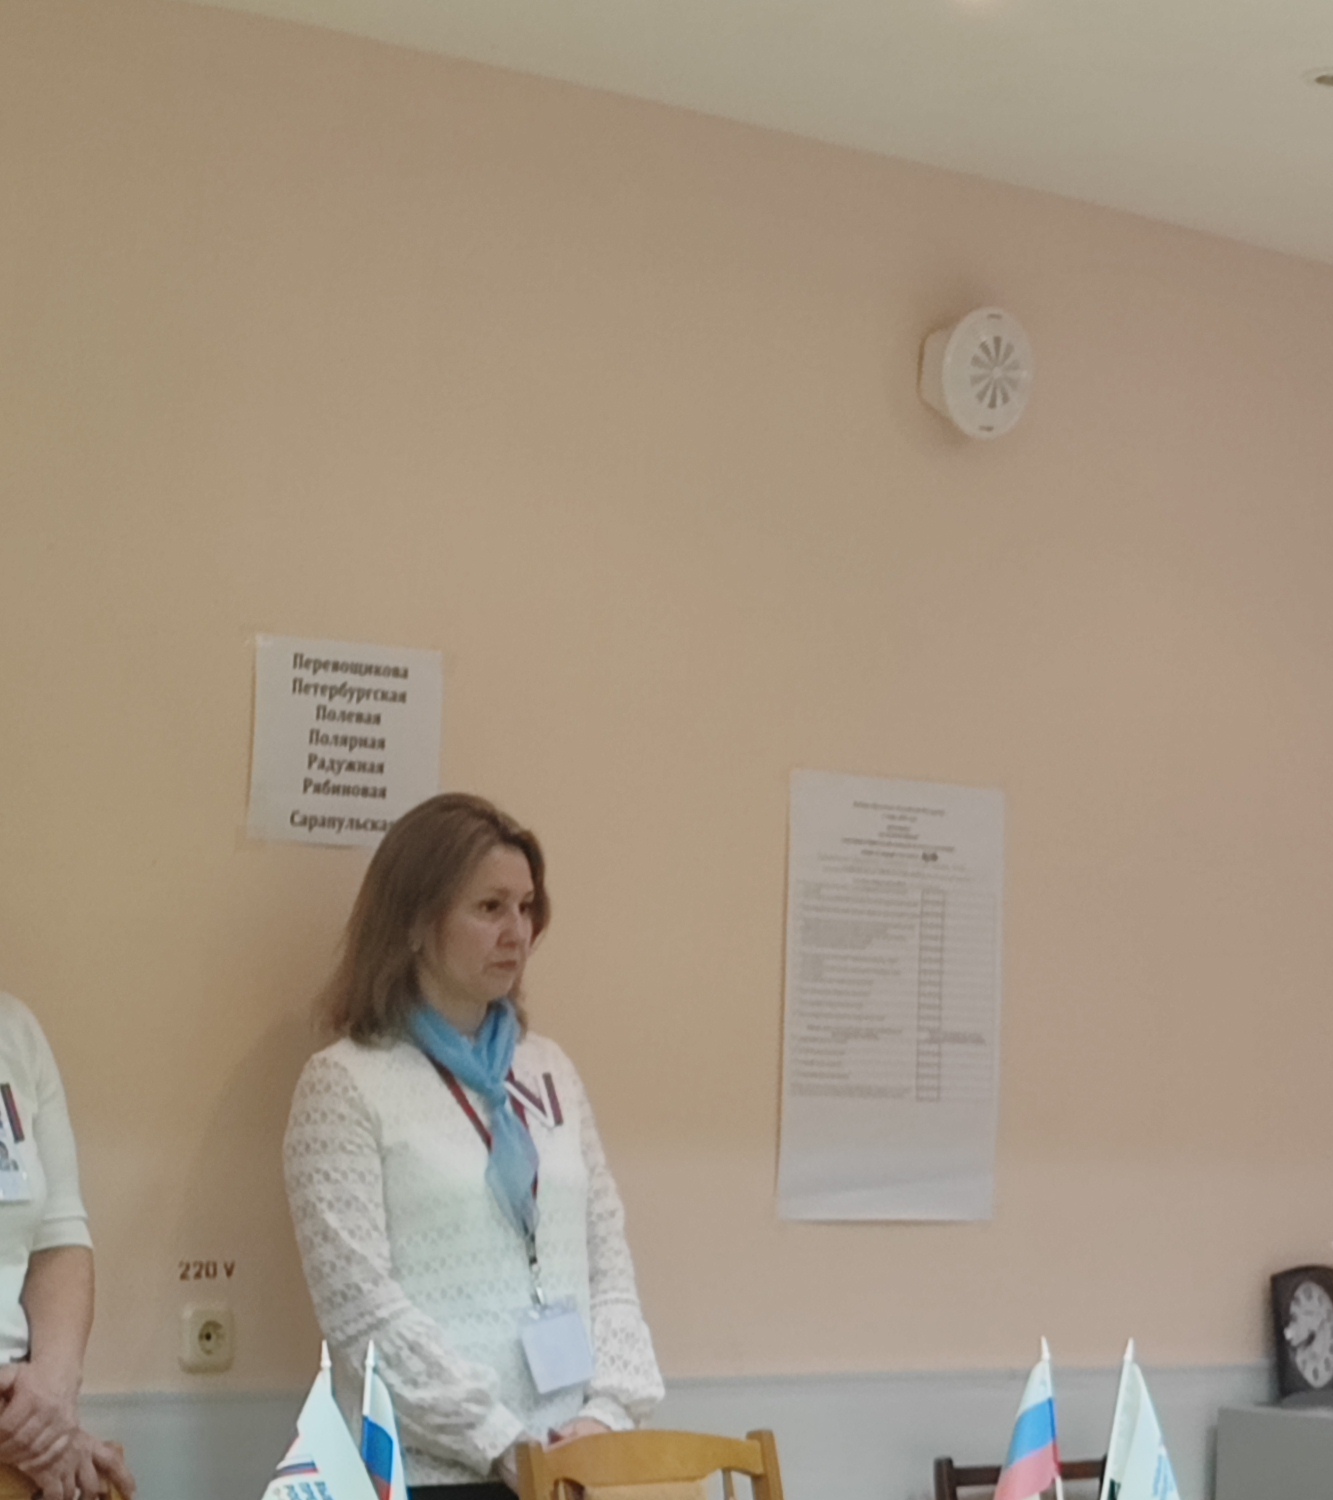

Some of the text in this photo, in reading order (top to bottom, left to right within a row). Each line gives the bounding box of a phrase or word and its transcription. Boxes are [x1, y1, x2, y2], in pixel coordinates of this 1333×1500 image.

[292, 652, 409, 680] Перевощикова
[292, 677, 407, 704] Петербургская
[315, 704, 382, 726] Полевая
[308, 728, 386, 752] Полярная
[307, 753, 385, 775] Радужная
[302, 777, 387, 800] Рябиновая
[289, 810, 395, 834] Сарапульска
[178, 1260, 236, 1281] 220 V
